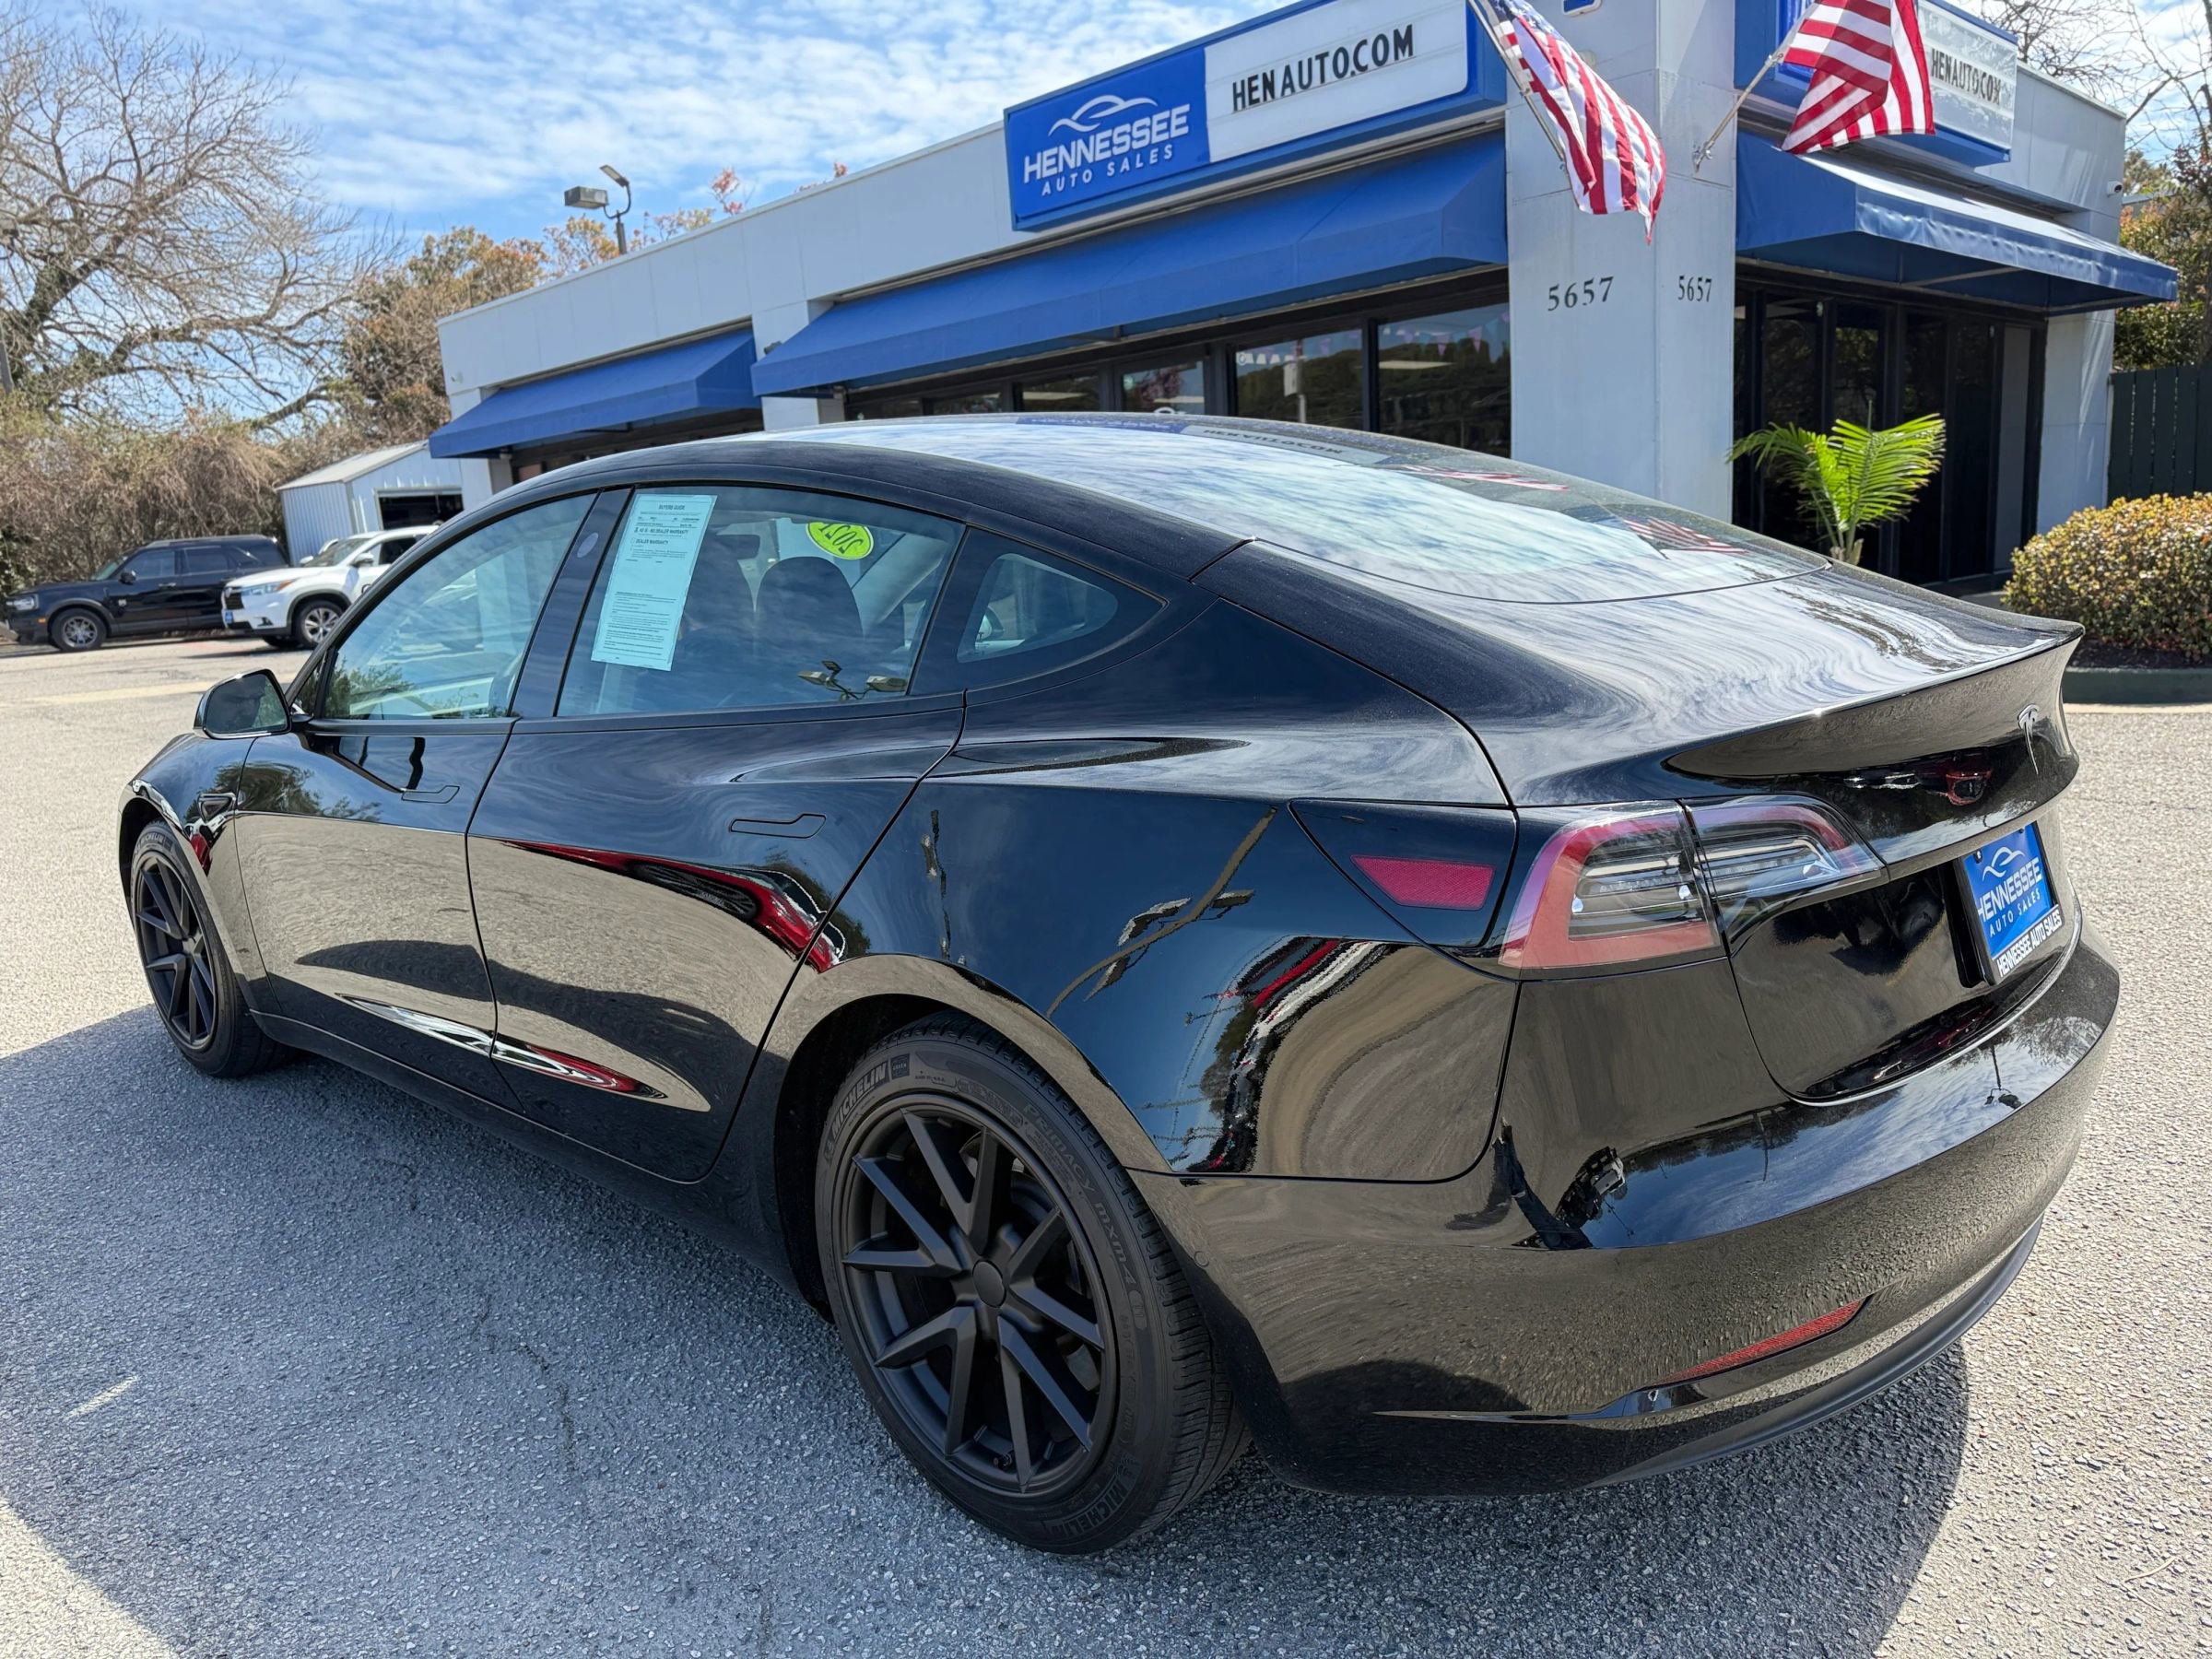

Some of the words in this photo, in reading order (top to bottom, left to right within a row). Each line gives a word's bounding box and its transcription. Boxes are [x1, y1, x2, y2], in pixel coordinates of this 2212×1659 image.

[1232, 24, 1414, 112] HENAUTO.COM
[1024, 103, 1191, 183] HENNESSEE
[1041, 169, 1092, 196] AUTO
[1107, 144, 1173, 177] SALES
[1547, 276, 1614, 312] 5657
[1677, 275, 1712, 302] 5657
[1977, 857, 2043, 922] HENNESSEE
[1990, 912, 2014, 938] AUTO
[2018, 888, 2041, 915] SALES
[1996, 935, 2031, 978] HENNESSEE
[2030, 928, 2045, 950] AUTO
[2044, 910, 2063, 937] SALES
[831, 1062, 887, 1140] MICHELIN
